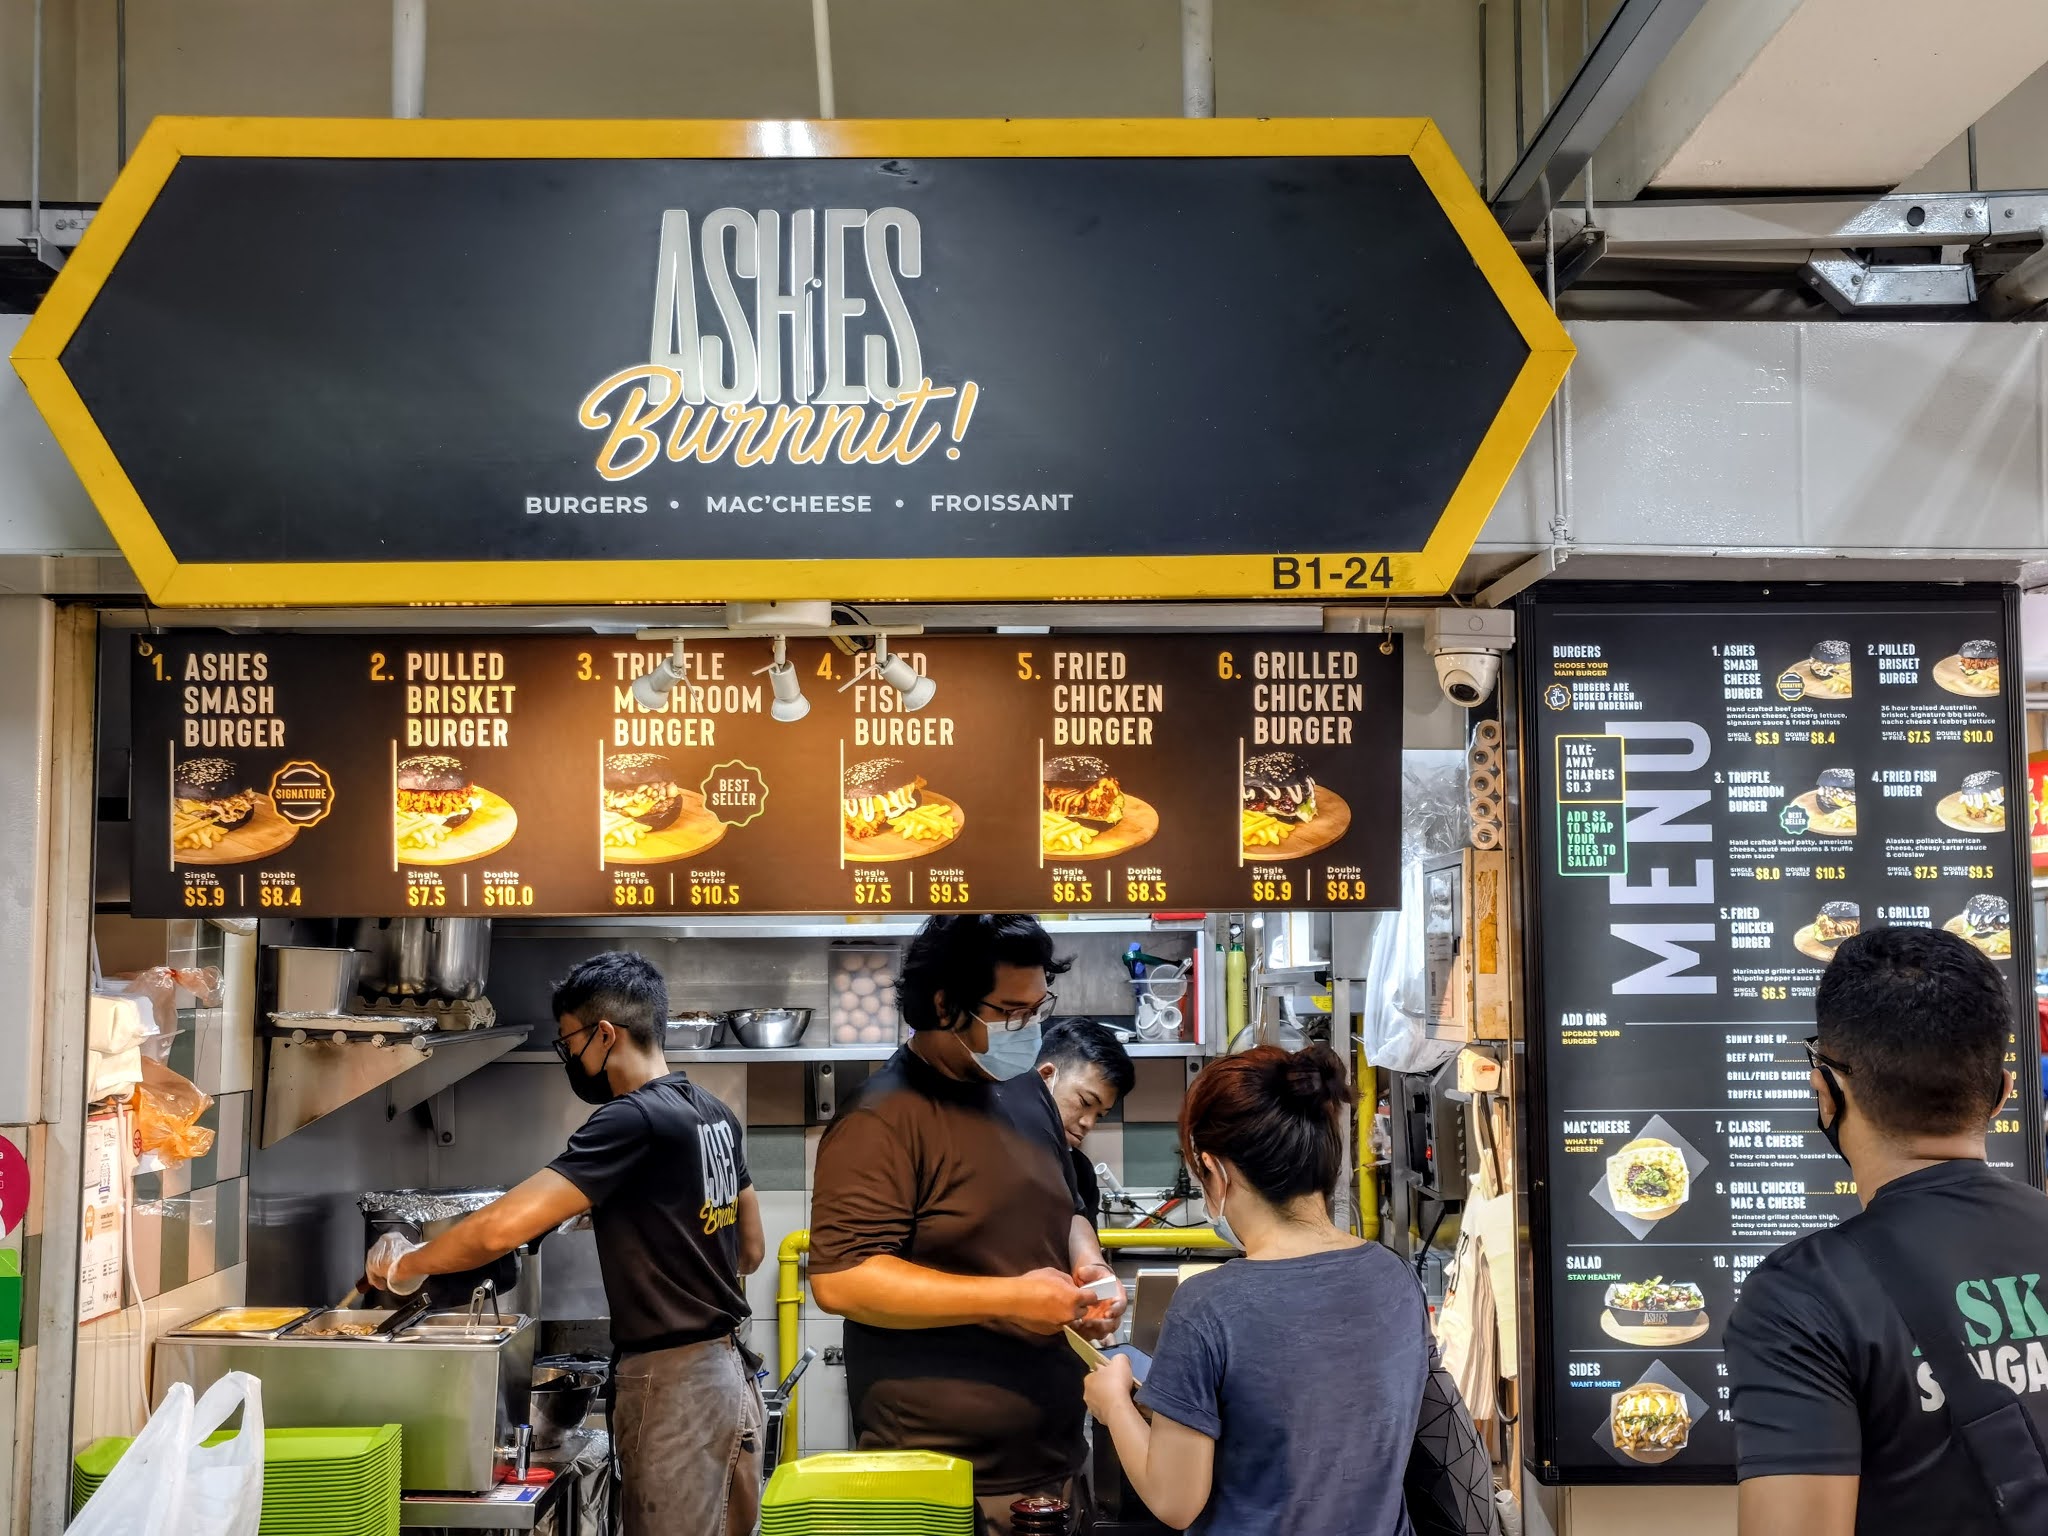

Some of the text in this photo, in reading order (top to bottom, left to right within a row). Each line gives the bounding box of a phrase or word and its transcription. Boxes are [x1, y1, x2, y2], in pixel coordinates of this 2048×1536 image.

[646, 207, 923, 406] ASHES
[579, 364, 979, 481] Burnnit!
[525, 494, 1074, 514] BURGERS MAC'CHEESE FROISSANT
[1273, 557, 1393, 590] B1-24
[1553, 646, 1601, 658] BURGERS
[1712, 645, 1755, 656] 1. ASHES
[1868, 644, 1916, 656] 2. PULLED
[151, 653, 268, 681] 1. ASHES
[370, 653, 504, 681] 2. PULLED
[577, 652, 601, 680] 3.
[817, 652, 841, 680] 4.
[1018, 652, 1126, 680] 5. FRIED
[1218, 652, 1358, 680] 6. GRILLED
[1723, 659, 1758, 671] SMASH
[1879, 658, 1920, 670] BRISKET
[1724, 673, 1761, 685] CHEESE
[1879, 672, 1918, 684] BURGER
[1573, 683, 1629, 692] BURGERS ARE
[1724, 687, 1763, 699] BURGER
[184, 686, 274, 714] SMASH
[407, 686, 516, 714] BRISKET
[1054, 685, 1163, 713] CHICKEN
[1254, 684, 1363, 712] CHICKEN
[1573, 692, 1635, 701] COOKED FRESH
[1573, 702, 1643, 710] UPON ORDERING!
[184, 719, 286, 747] BURGER
[407, 719, 509, 747] BURGER
[614, 718, 716, 746] BURGER
[855, 718, 954, 746] BURGER
[1054, 717, 1153, 745] BURGER
[1254, 717, 1353, 744] BURGER
[1907, 730, 1994, 743] $7.5 $10.0
[1755, 732, 1835, 744] $5.9 $8.4
[1565, 744, 1596, 755] TAKE-
[1566, 756, 1594, 768] AWAY
[1566, 769, 1615, 780] CHARGES
[1714, 771, 1770, 784] 3. TRUFFLE
[1871, 770, 1937, 782] 4. FRIED FISH
[719, 779, 749, 792] BEST
[1728, 786, 1784, 798] MUSHROOM
[1883, 785, 1923, 797] BURGER
[275, 788, 327, 800] SIGNATURE
[712, 793, 757, 806] SELLER
[1729, 800, 1768, 812] BURGER
[1567, 811, 1588, 822] ADD
[1567, 823, 1614, 833] TO SWAP
[1568, 834, 1595, 844] YOUR
[1568, 845, 1616, 856] FRIES TO
[1568, 856, 1608, 867] SALAD!
[1605, 721, 1717, 994] MENU
[184, 872, 216, 881] Single
[261, 871, 296, 880] Double
[407, 872, 439, 881] Single
[483, 871, 519, 880] Double
[614, 871, 646, 879] Single
[691, 870, 726, 878] Double
[854, 869, 885, 878] Single
[930, 869, 965, 877] Double
[1053, 868, 1084, 876] Single
[1127, 867, 1162, 876] Double
[1253, 867, 1284, 876] Single
[1327, 866, 1361, 875] Double
[1756, 867, 1845, 880] $8.0 $10.5
[1914, 866, 1993, 879] $7.5 $9.5
[184, 886, 225, 907] $5.9
[261, 886, 301, 907] $8.4
[408, 886, 445, 907] $7.5
[483, 886, 533, 907] $10.0
[614, 885, 655, 905] $8.0
[691, 885, 740, 905] $10.5
[854, 883, 892, 904] $7.5
[930, 883, 969, 903] $9.5
[1053, 882, 1092, 902] $6.5
[1127, 882, 1166, 902] $8.5
[1253, 881, 1292, 902] $6.9
[1327, 881, 1366, 901] $8.9
[1731, 907, 1759, 919] FRIED
[1877, 906, 1930, 919] 6. GRILLED
[1731, 922, 1774, 934] CHICKEN
[1732, 936, 1771, 949] BURGER
[1762, 986, 1786, 1000] $6.5
[1561, 1013, 1607, 1026] ADD ONS
[1726, 1034, 1752, 1044] SUNNY
[1755, 1034, 1774, 1044] SIDE
[1726, 1053, 1774, 1062] BEEF PATTY
[1727, 1071, 1811, 1080] GRILL/FRIED CHICKE
[1727, 1090, 1810, 1099] TRUFFLE MUSHROOM
[1563, 1120, 1631, 1134] MAC'CHEESE
[1715, 1121, 1771, 1133] 7. CLASSIC
[1995, 1120, 2019, 1133] $6.0
[1729, 1135, 1804, 1147] MAC & CHEESE
[1715, 1182, 1857, 1194] 9. GRILL CHICKEN $7.0
[1566, 1256, 1602, 1269] SALAD
[1569, 1363, 1601, 1376] SIDES
